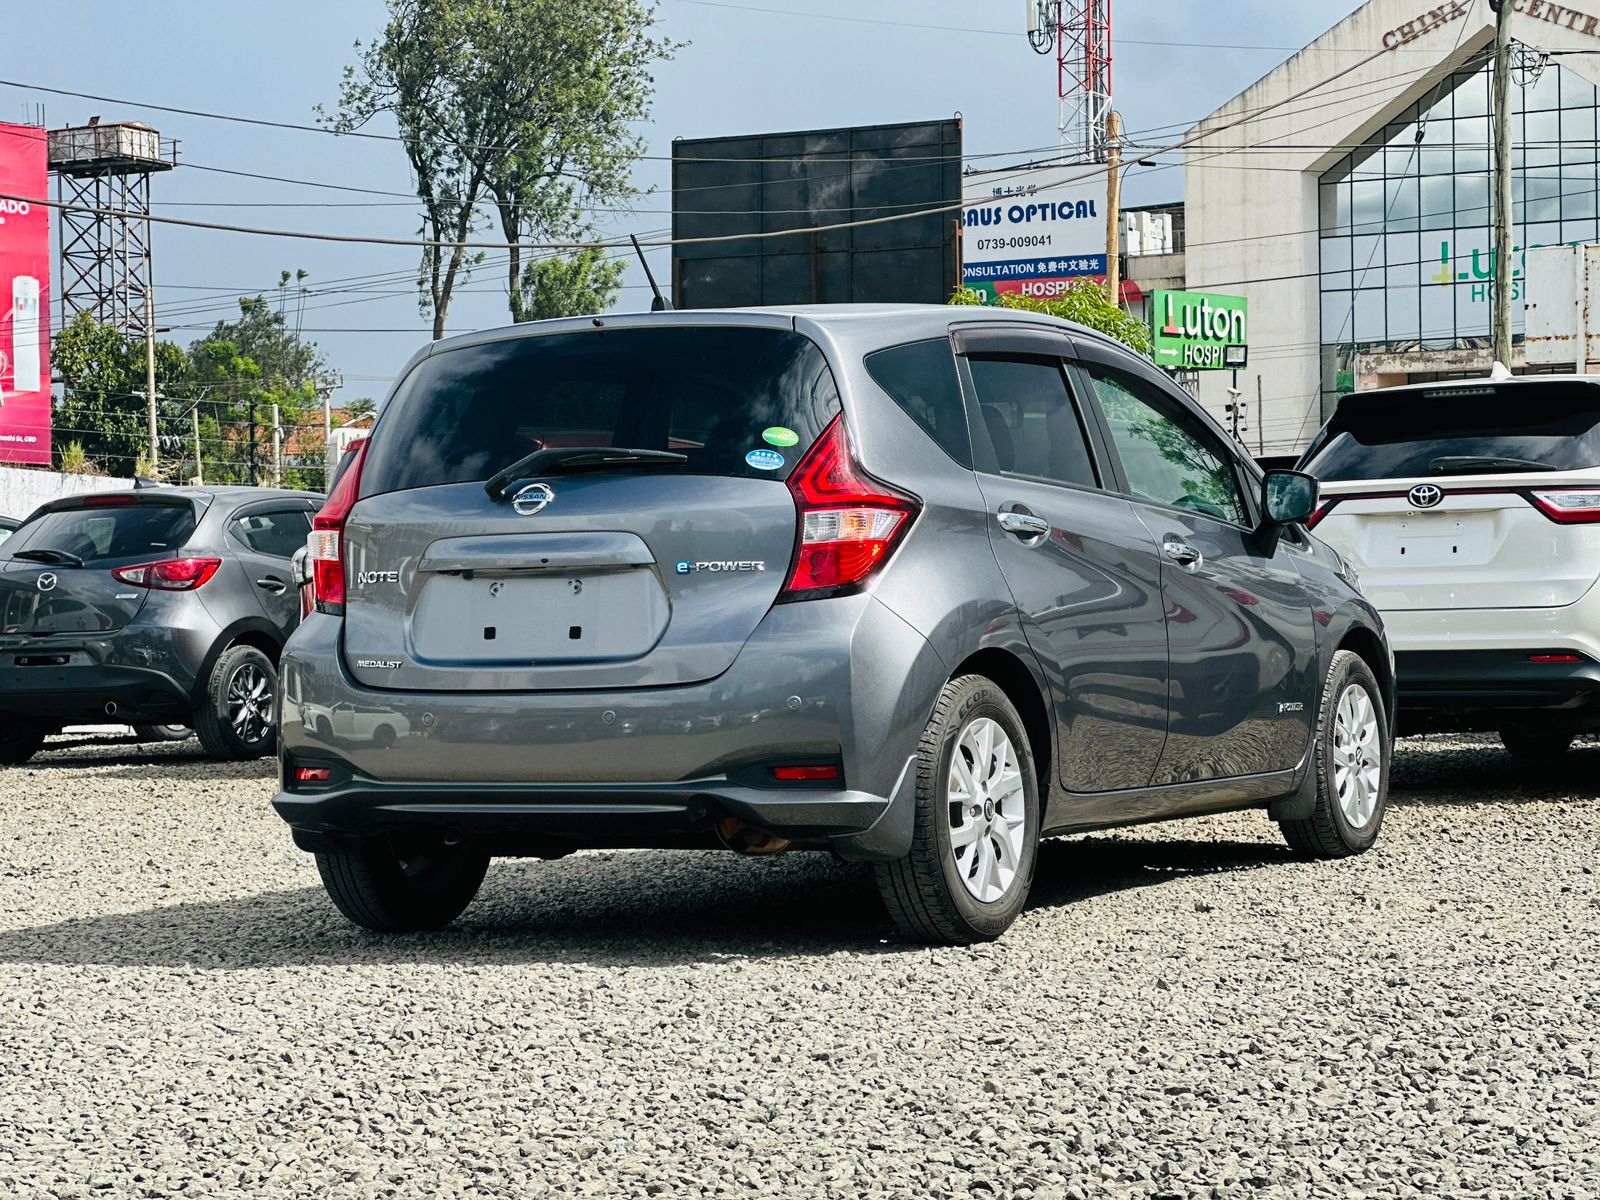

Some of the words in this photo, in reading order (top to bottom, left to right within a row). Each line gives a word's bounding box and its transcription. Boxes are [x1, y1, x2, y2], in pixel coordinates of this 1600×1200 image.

[1382, 0, 1467, 50] CHINA
[1512, 0, 1600, 38] CENTR
[1007, 199, 1097, 224] OPTICAL
[977, 234, 1052, 250] 0739-009041
[1037, 258, 1099, 273] 免费中文验光
[1021, 280, 1083, 297] HOSPI
[1163, 293, 1245, 340] Luton
[676, 560, 765, 575] e-POWER
[358, 571, 398, 583] NOTE
[357, 660, 401, 669] MEDALIST
[958, 689, 998, 719] ECOPI
